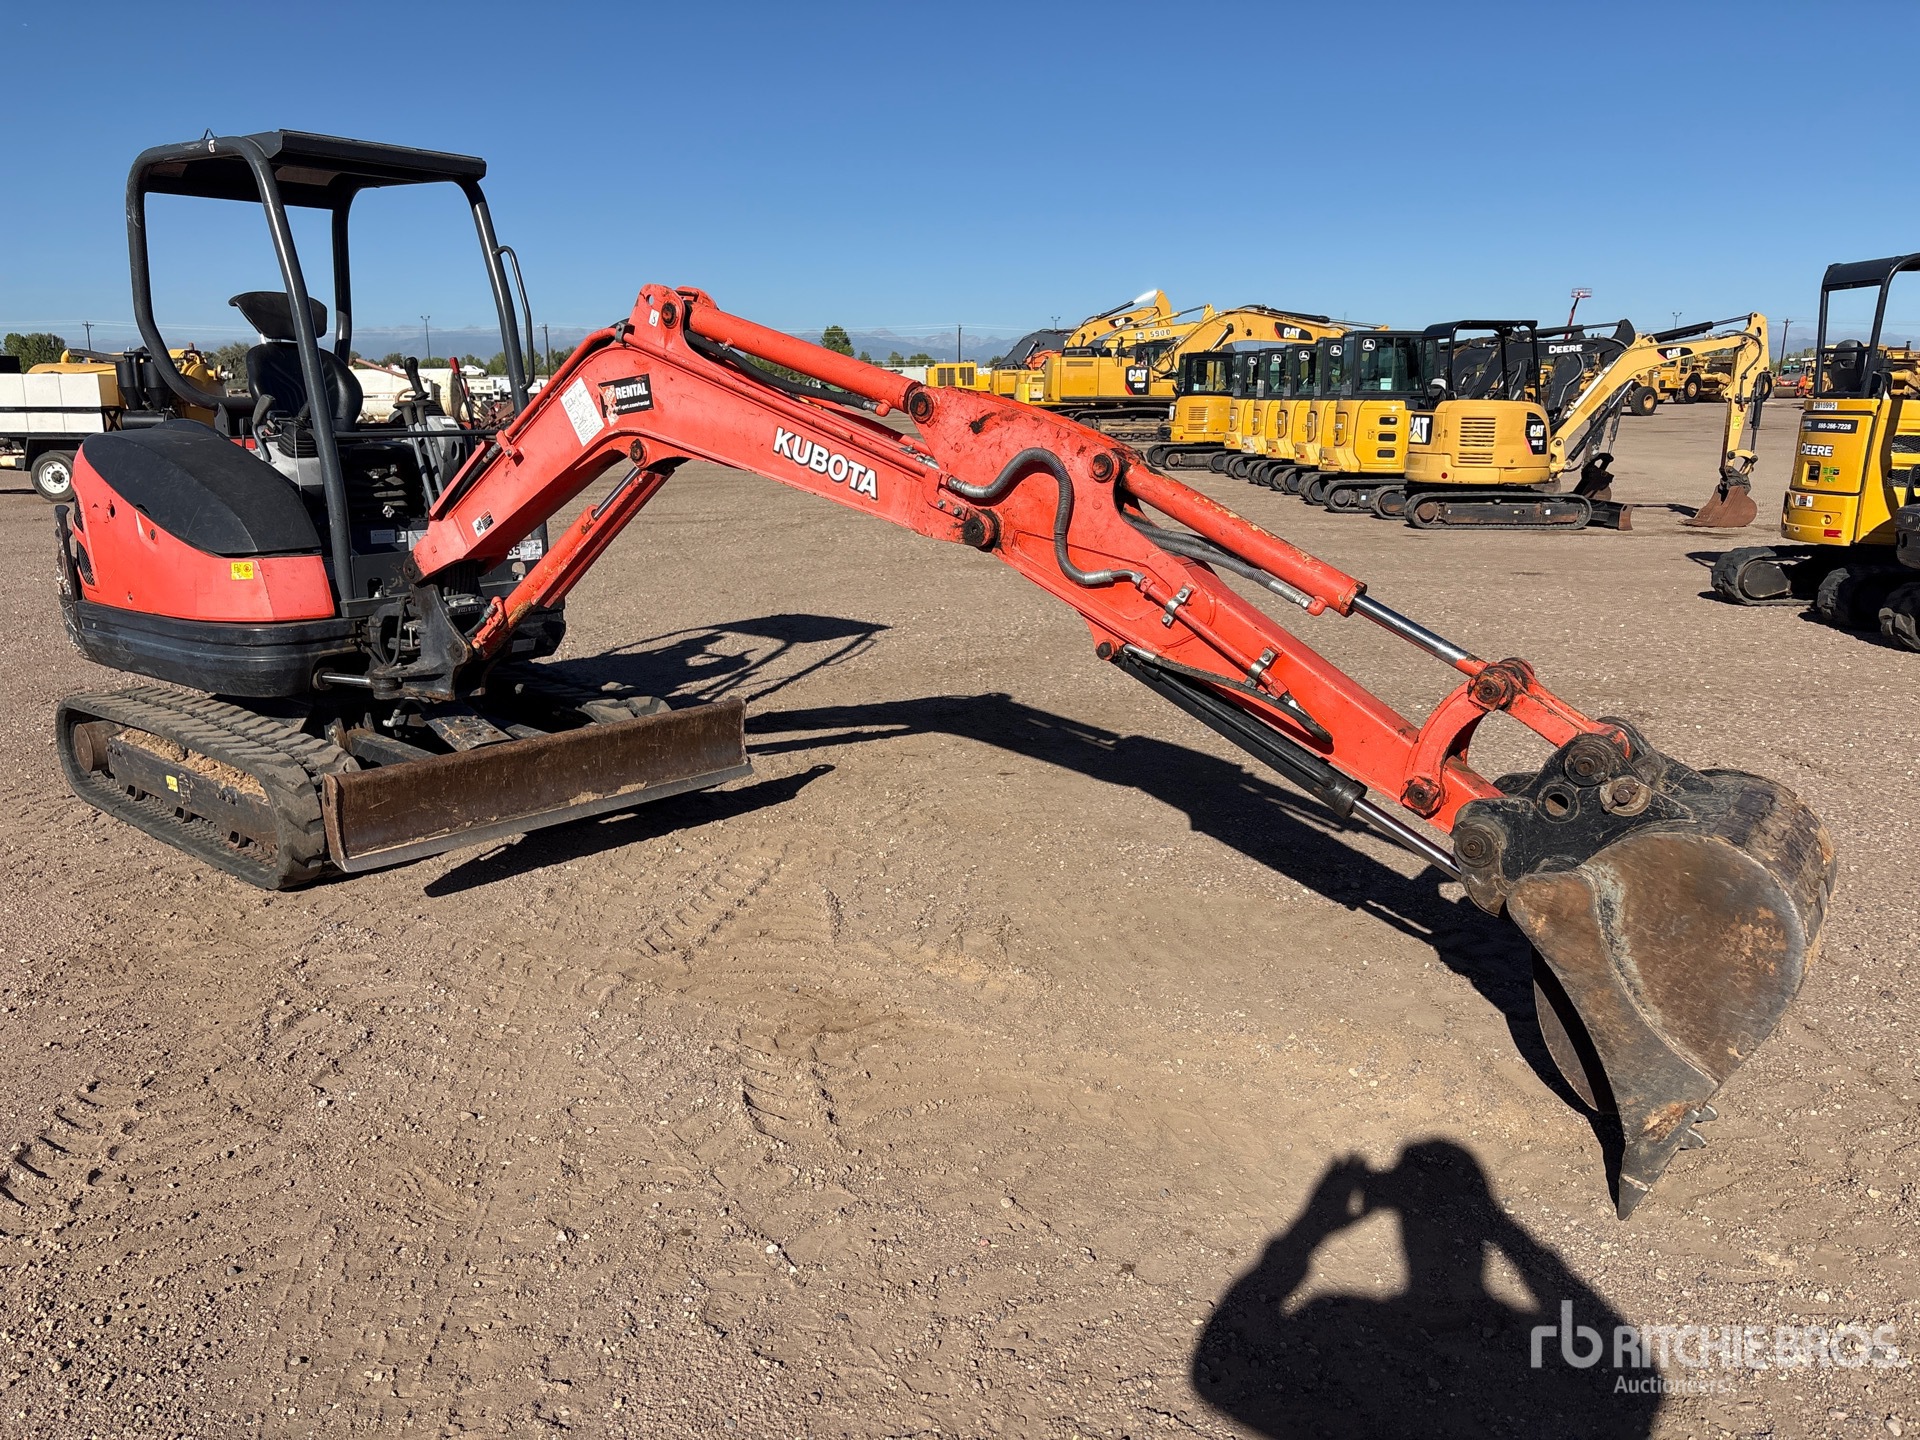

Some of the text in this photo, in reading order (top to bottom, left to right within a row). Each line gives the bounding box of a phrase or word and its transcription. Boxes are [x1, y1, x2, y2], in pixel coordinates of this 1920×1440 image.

[1114, 317, 1126, 327] CAT
[1283, 327, 1301, 339] CAT
[1548, 344, 1582, 354] DEERE
[1666, 347, 1681, 359] CAT
[1128, 369, 1147, 381] CAT
[615, 382, 649, 400] RENTAL
[1530, 424, 1545, 437] CAT
[1800, 443, 1834, 457] DEERE
[773, 426, 878, 500] KUBOTA
